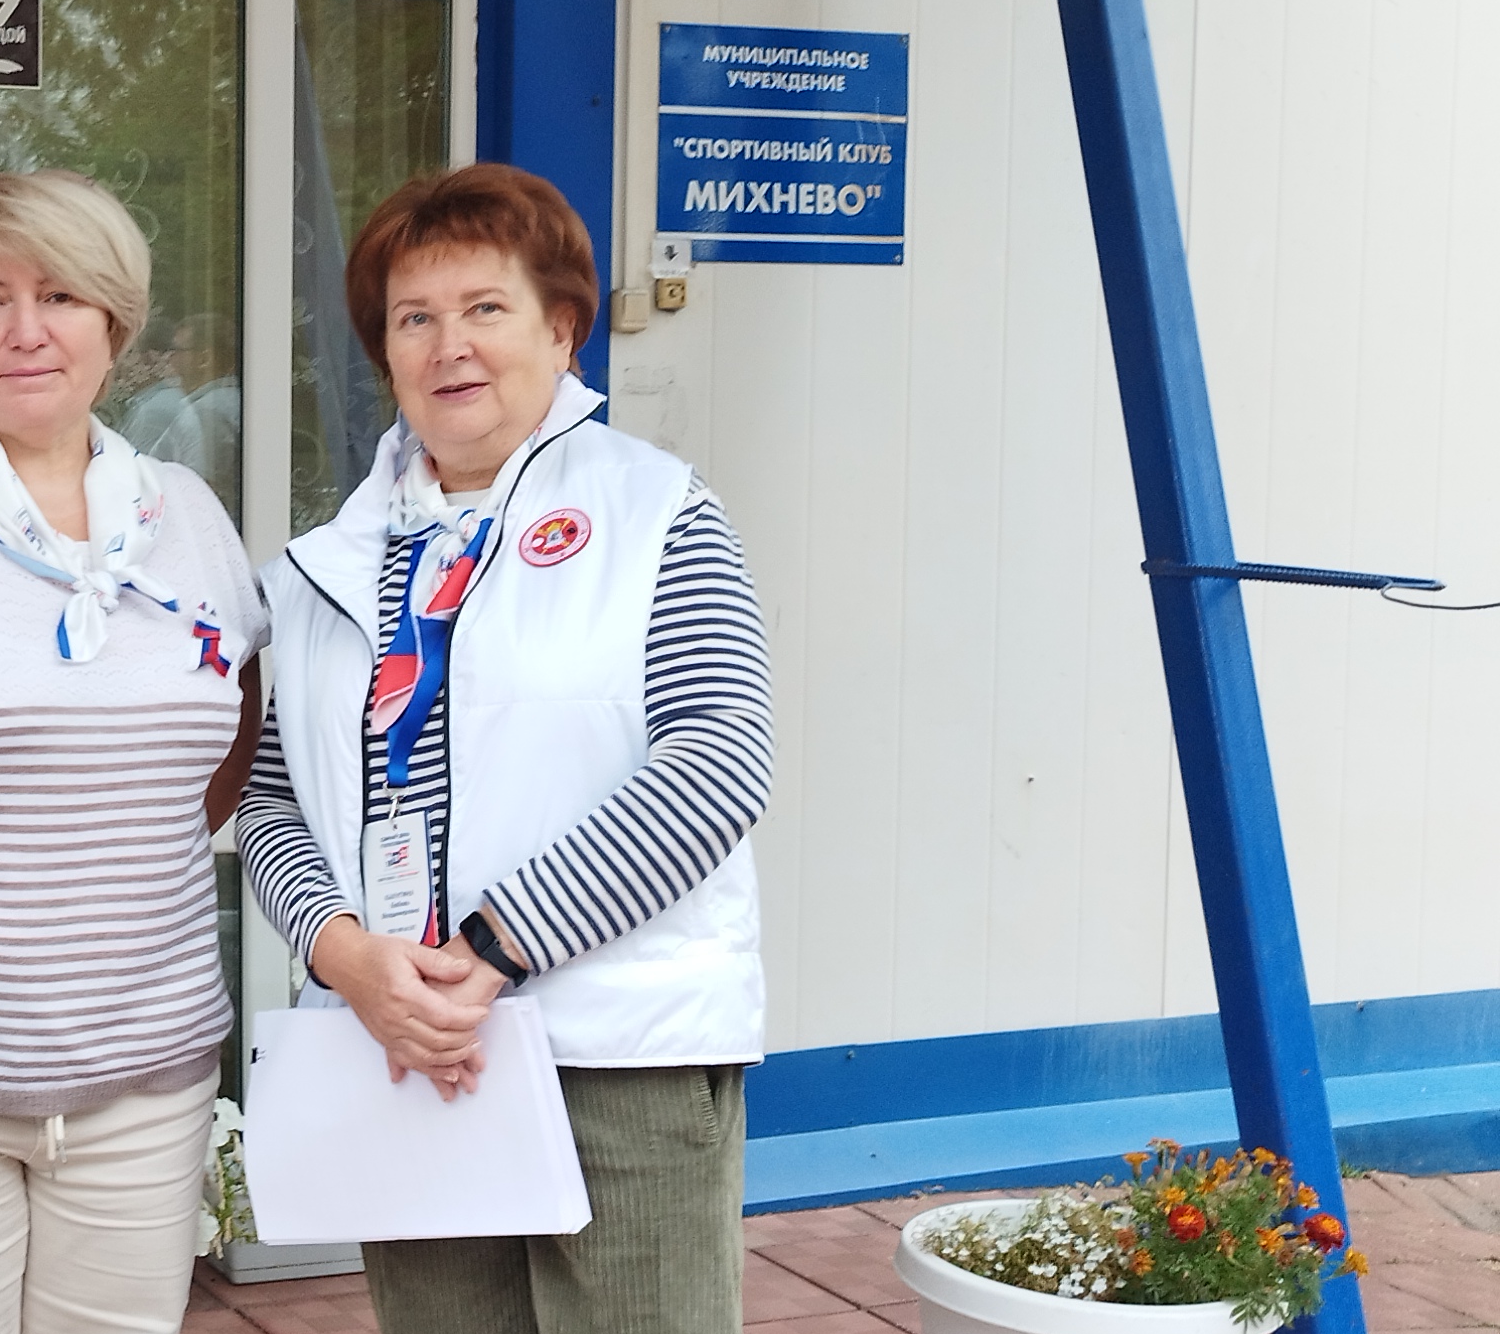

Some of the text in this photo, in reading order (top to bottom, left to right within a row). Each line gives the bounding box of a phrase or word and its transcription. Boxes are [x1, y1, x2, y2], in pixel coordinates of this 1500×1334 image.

[703, 44, 870, 70] МУНИЦИПАЛЬНОЕ
[727, 69, 847, 92] УЧРЕЖДЕНИЕ
[674, 137, 893, 165] "СПОРТИВНЫЙ КЛУБ
[684, 180, 882, 217] МИХНЕВО"
